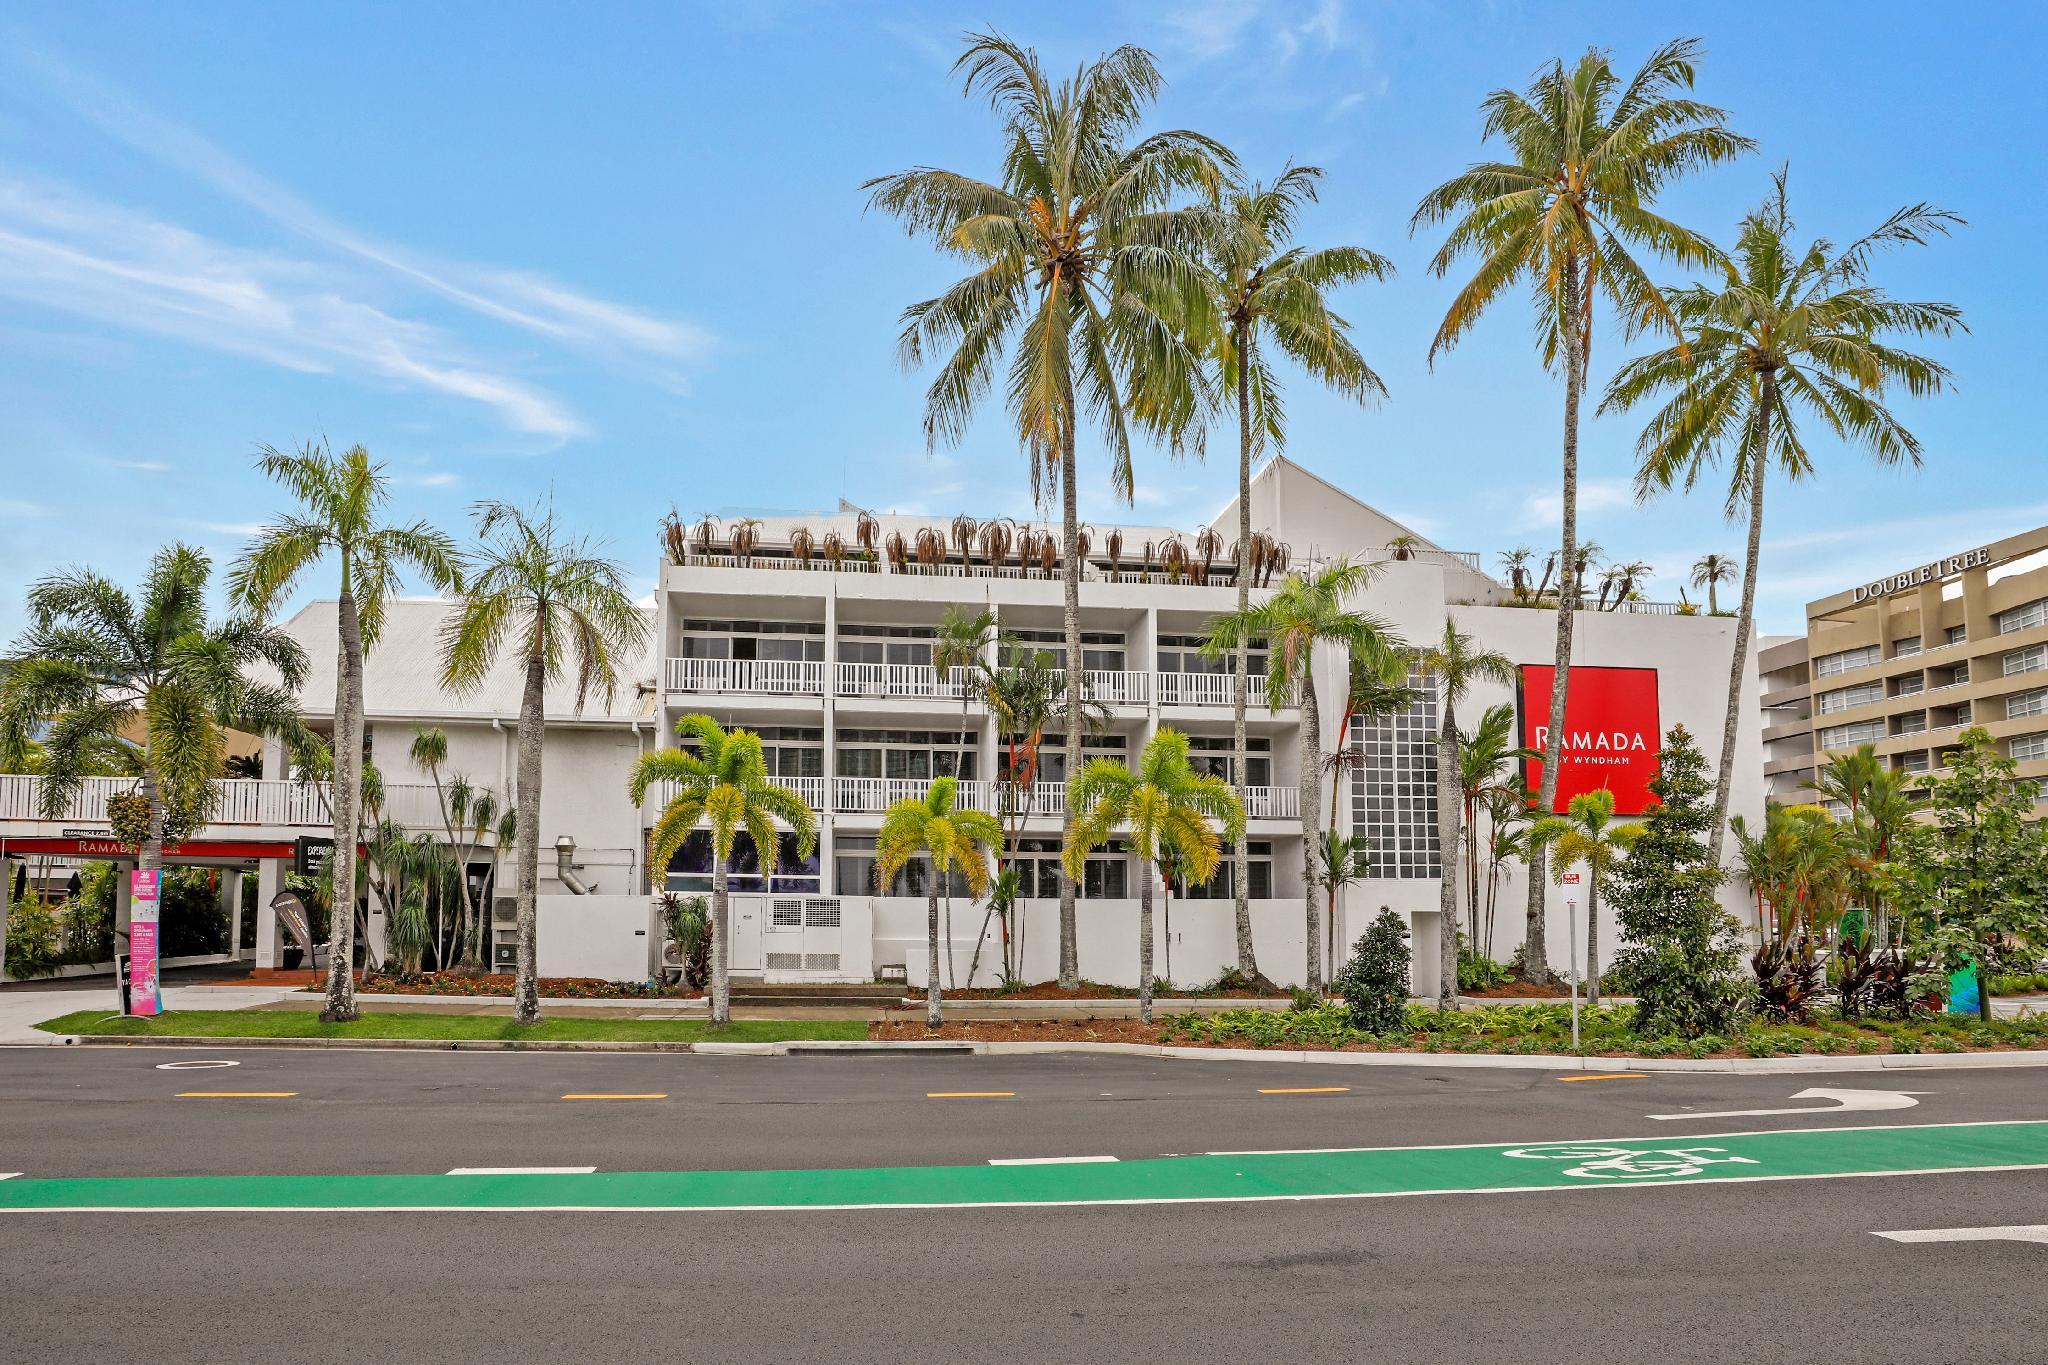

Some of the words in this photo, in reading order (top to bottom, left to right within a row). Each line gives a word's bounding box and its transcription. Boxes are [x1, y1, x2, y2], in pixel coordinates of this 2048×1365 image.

[1852, 548, 1990, 603] DOUBLETREE
[1573, 756, 1629, 765] WYNDHAM
[79, 841, 139, 854] RAMAD
